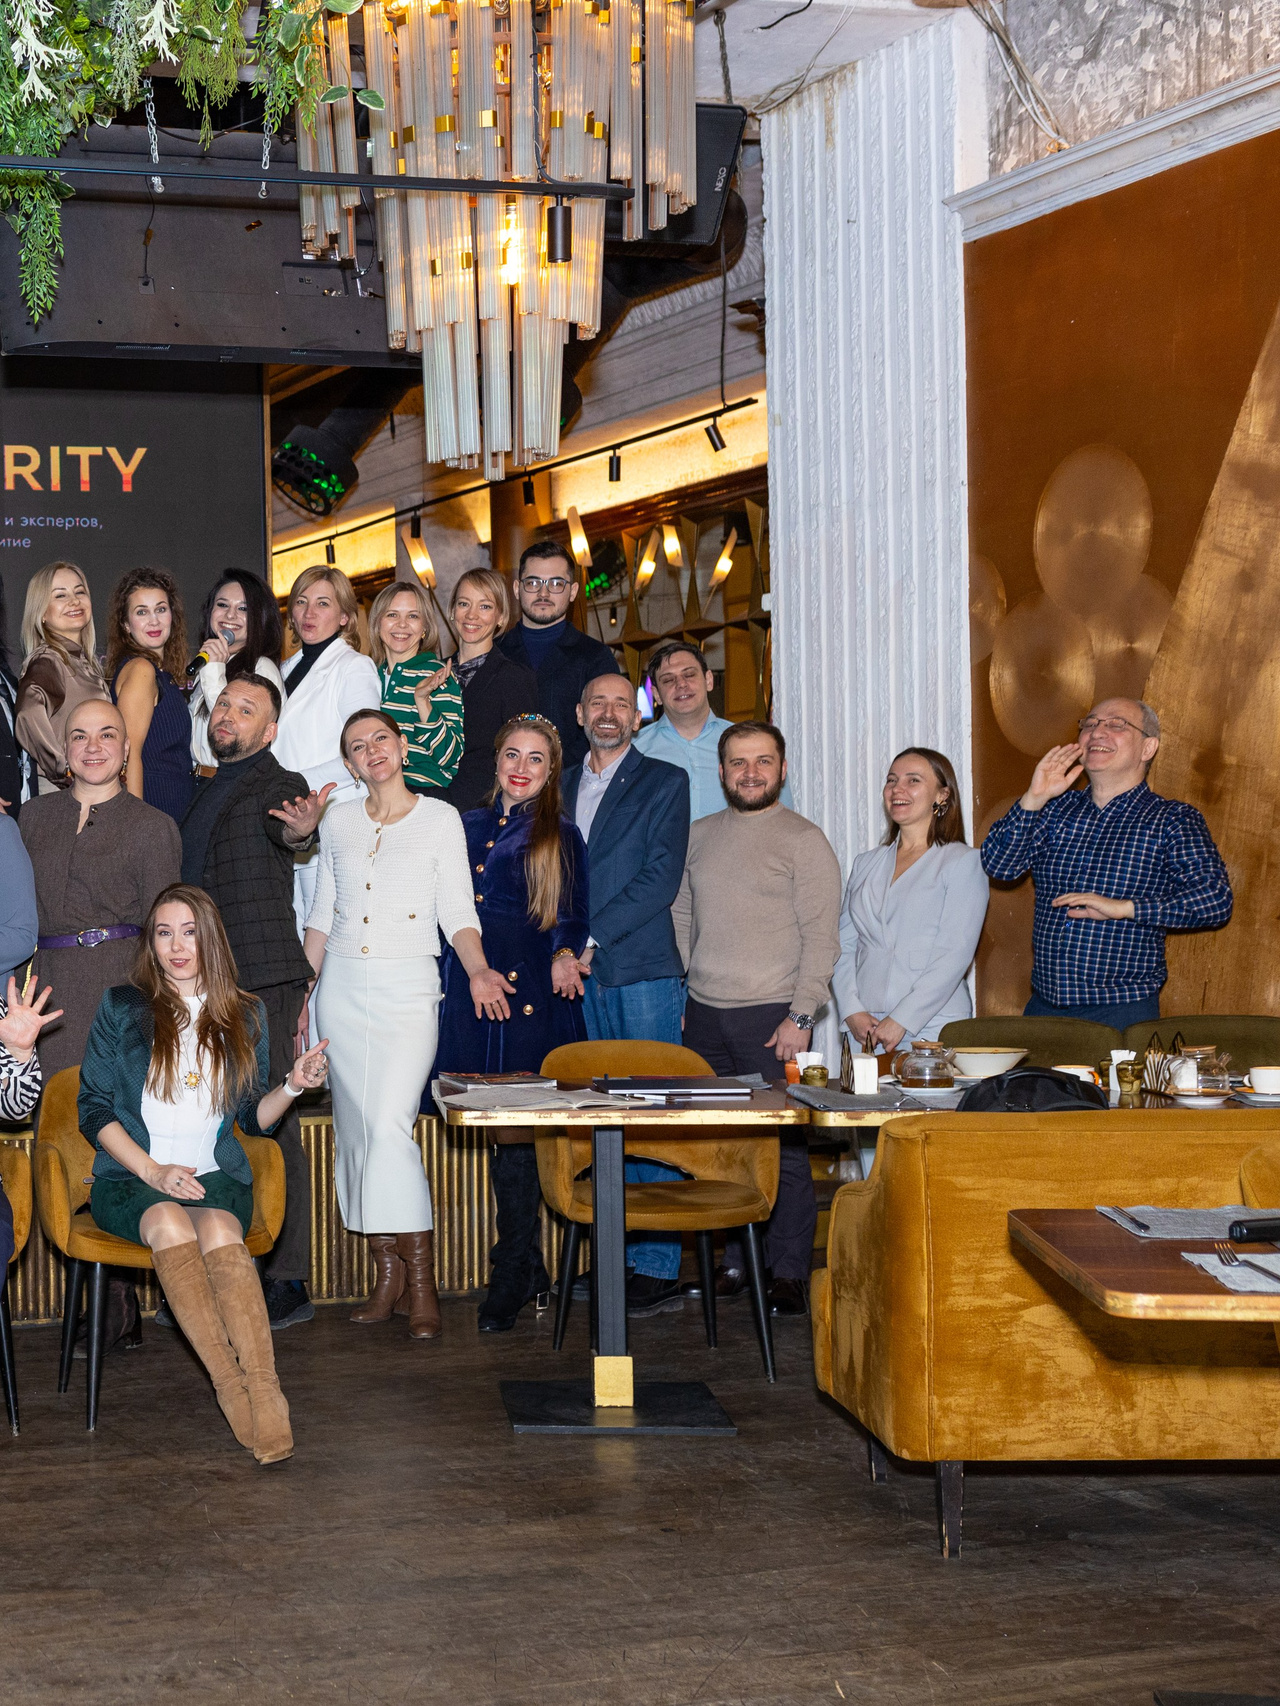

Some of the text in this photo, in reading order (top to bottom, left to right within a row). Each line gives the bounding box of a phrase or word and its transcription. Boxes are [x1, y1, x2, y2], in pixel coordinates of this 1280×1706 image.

[714, 166, 727, 191] NEXO
[4, 515, 14, 526] и
[20, 515, 103, 530] экспертов,
